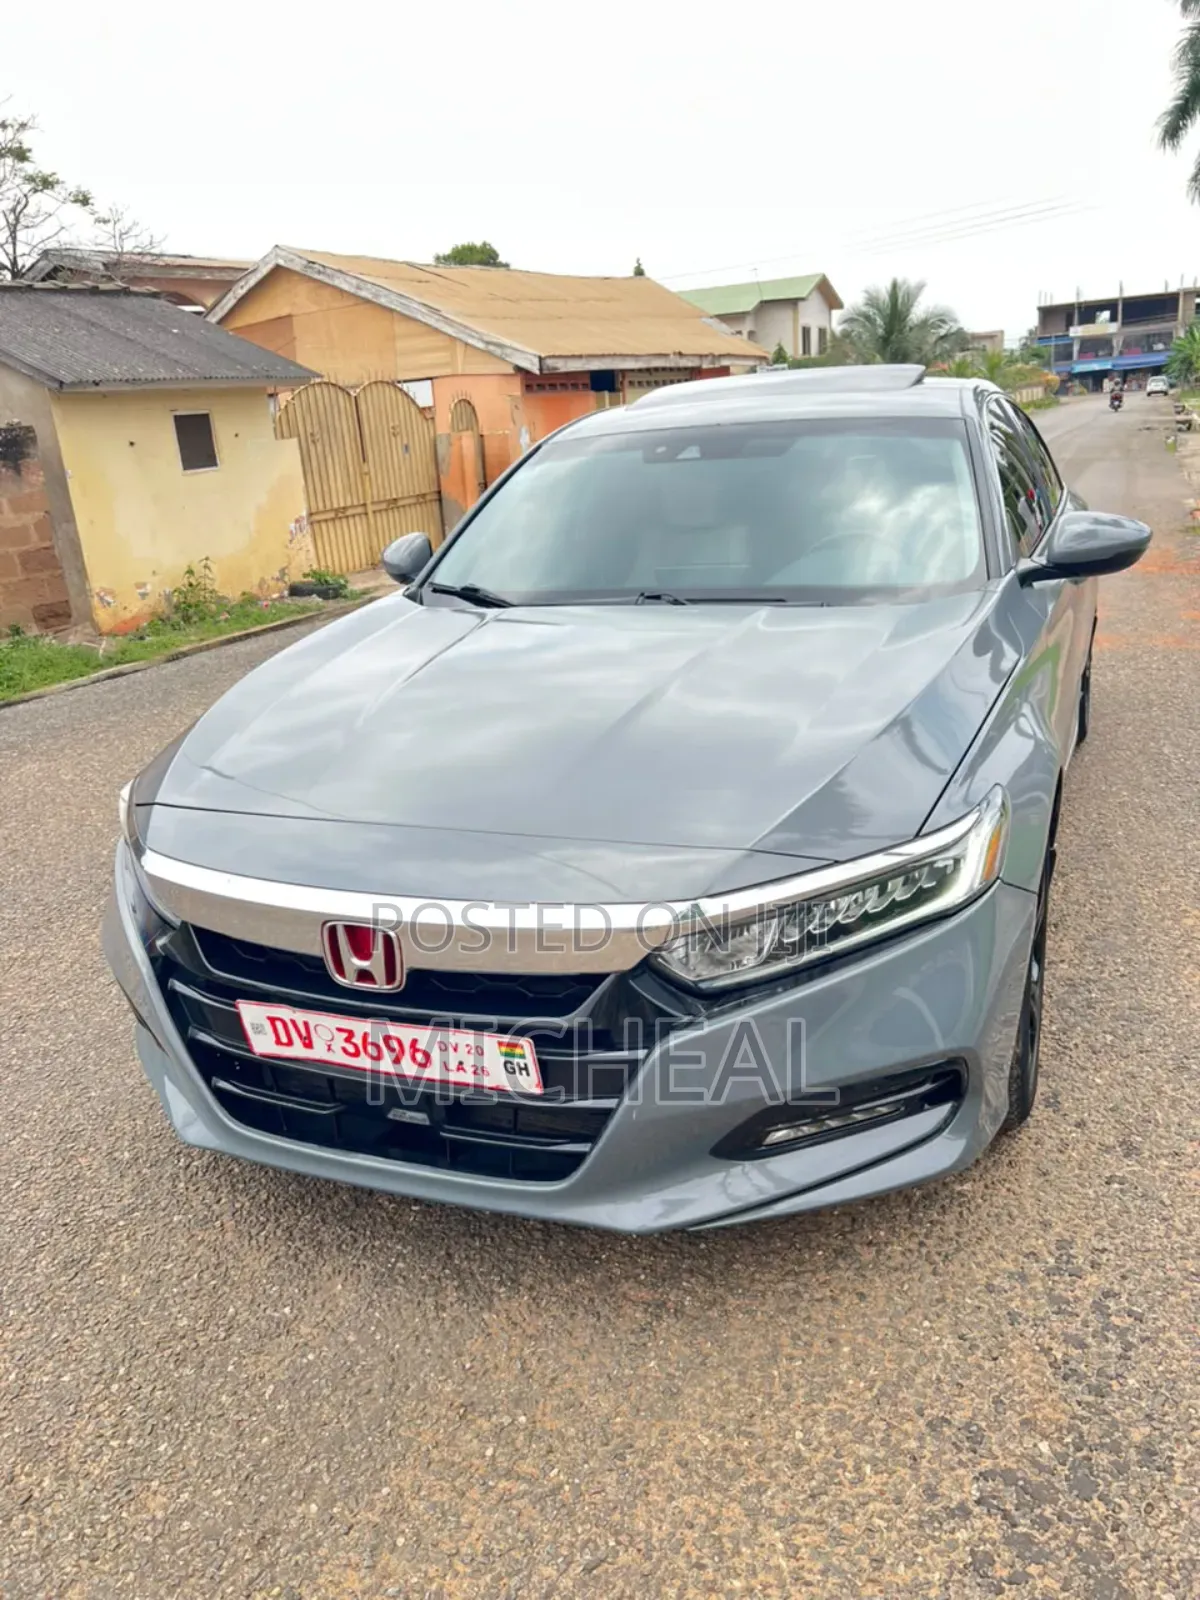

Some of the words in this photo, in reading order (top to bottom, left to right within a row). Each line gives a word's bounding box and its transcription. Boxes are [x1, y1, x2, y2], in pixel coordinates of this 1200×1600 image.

[266, 1015, 314, 1050] DV
[335, 1026, 432, 1069] 3696
[437, 1040, 459, 1054] DV
[465, 1043, 484, 1057] 20
[442, 1061, 467, 1074] LA
[503, 1060, 530, 1077] GH
